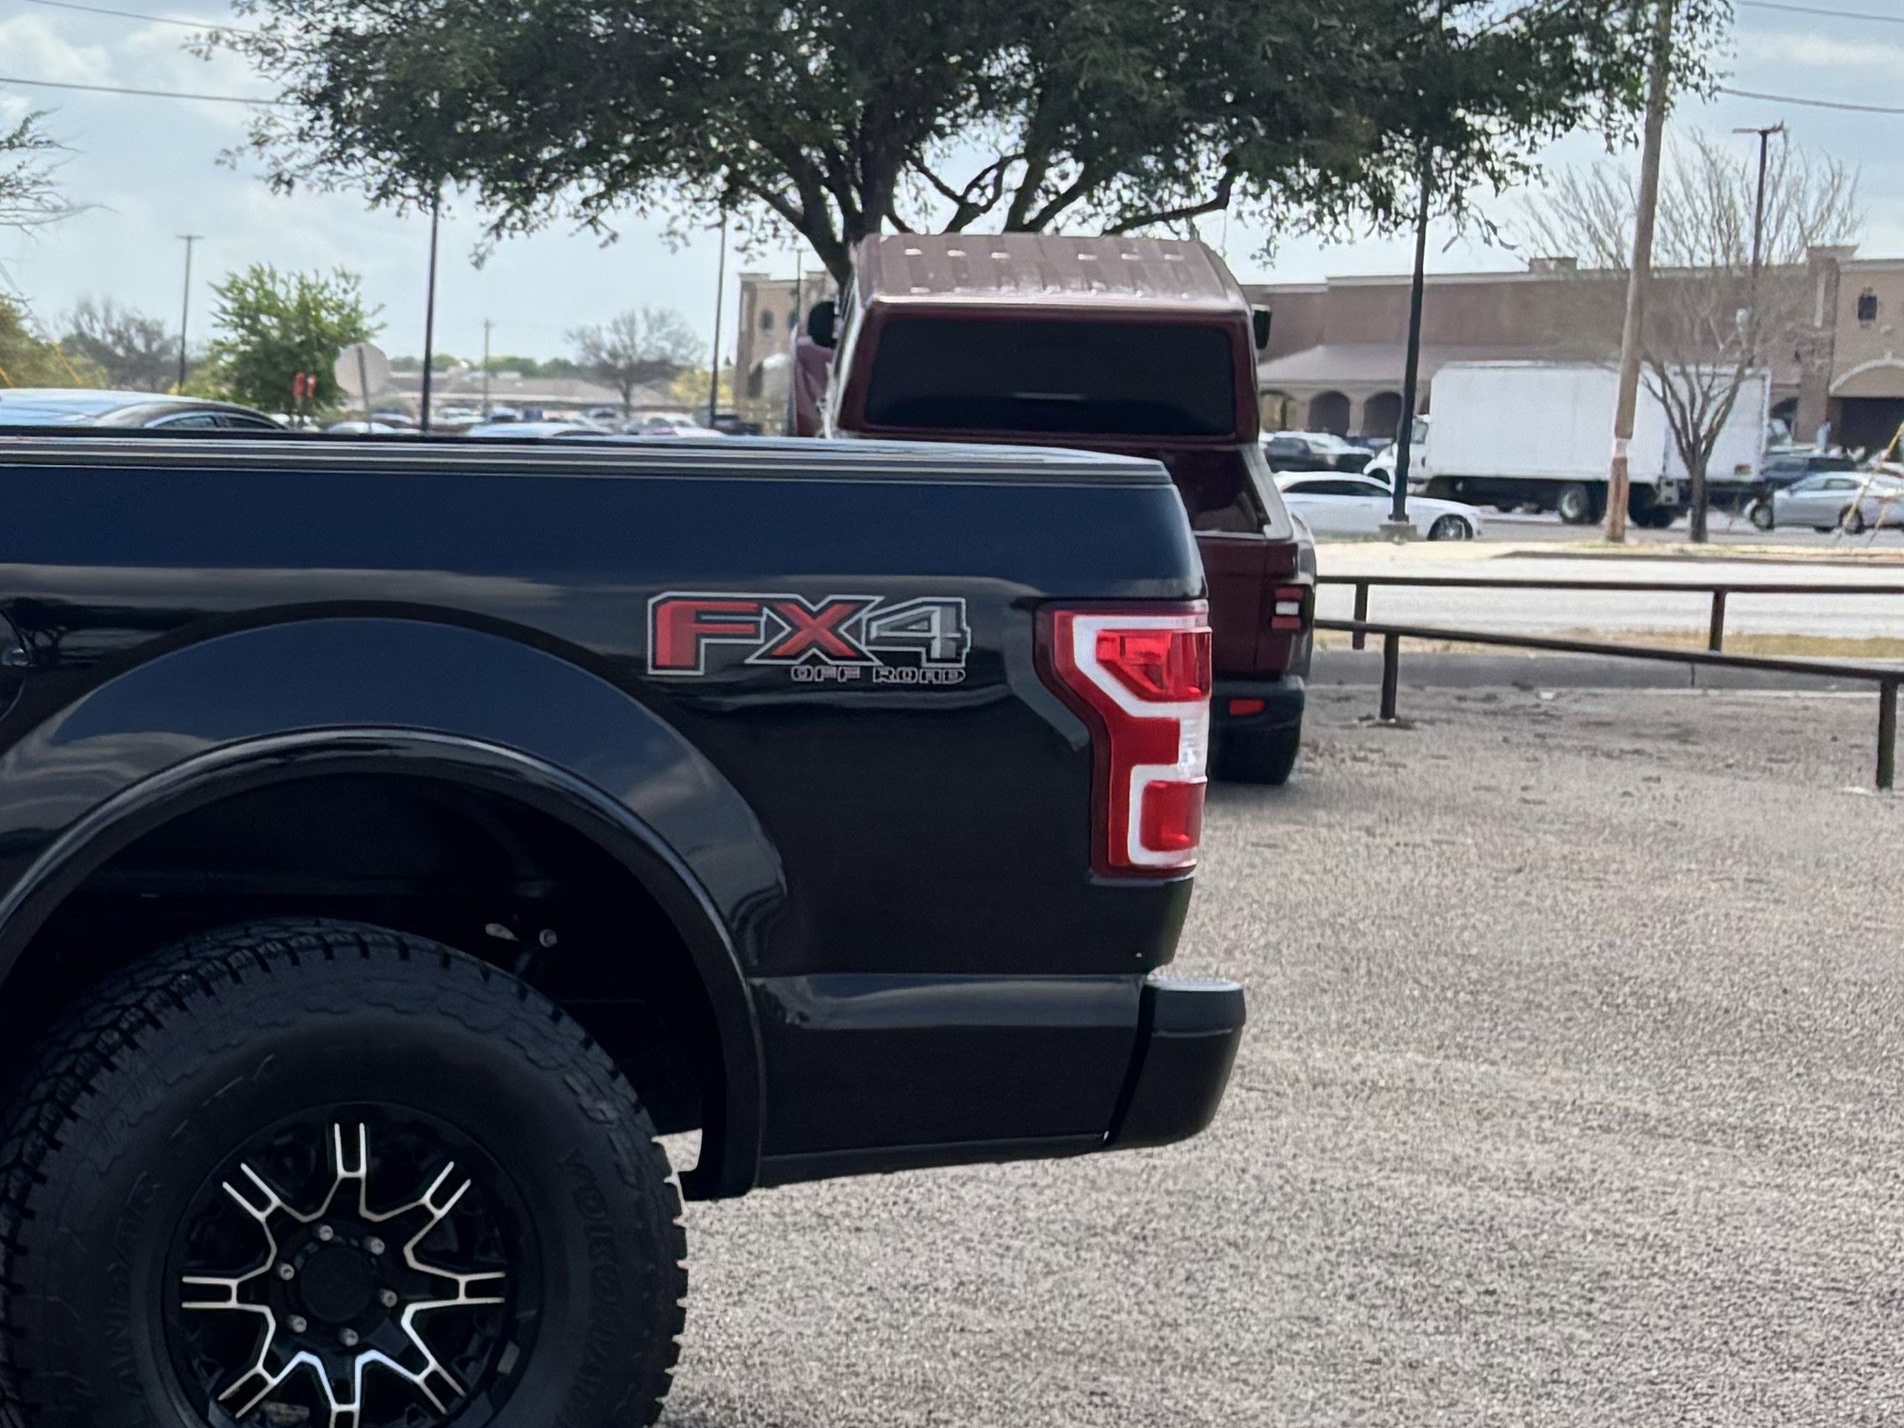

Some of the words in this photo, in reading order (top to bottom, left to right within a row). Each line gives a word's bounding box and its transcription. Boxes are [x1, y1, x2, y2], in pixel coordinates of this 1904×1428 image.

[647, 591, 971, 676] FX4
[791, 666, 861, 683] OFF
[873, 667, 966, 685] ROAD
